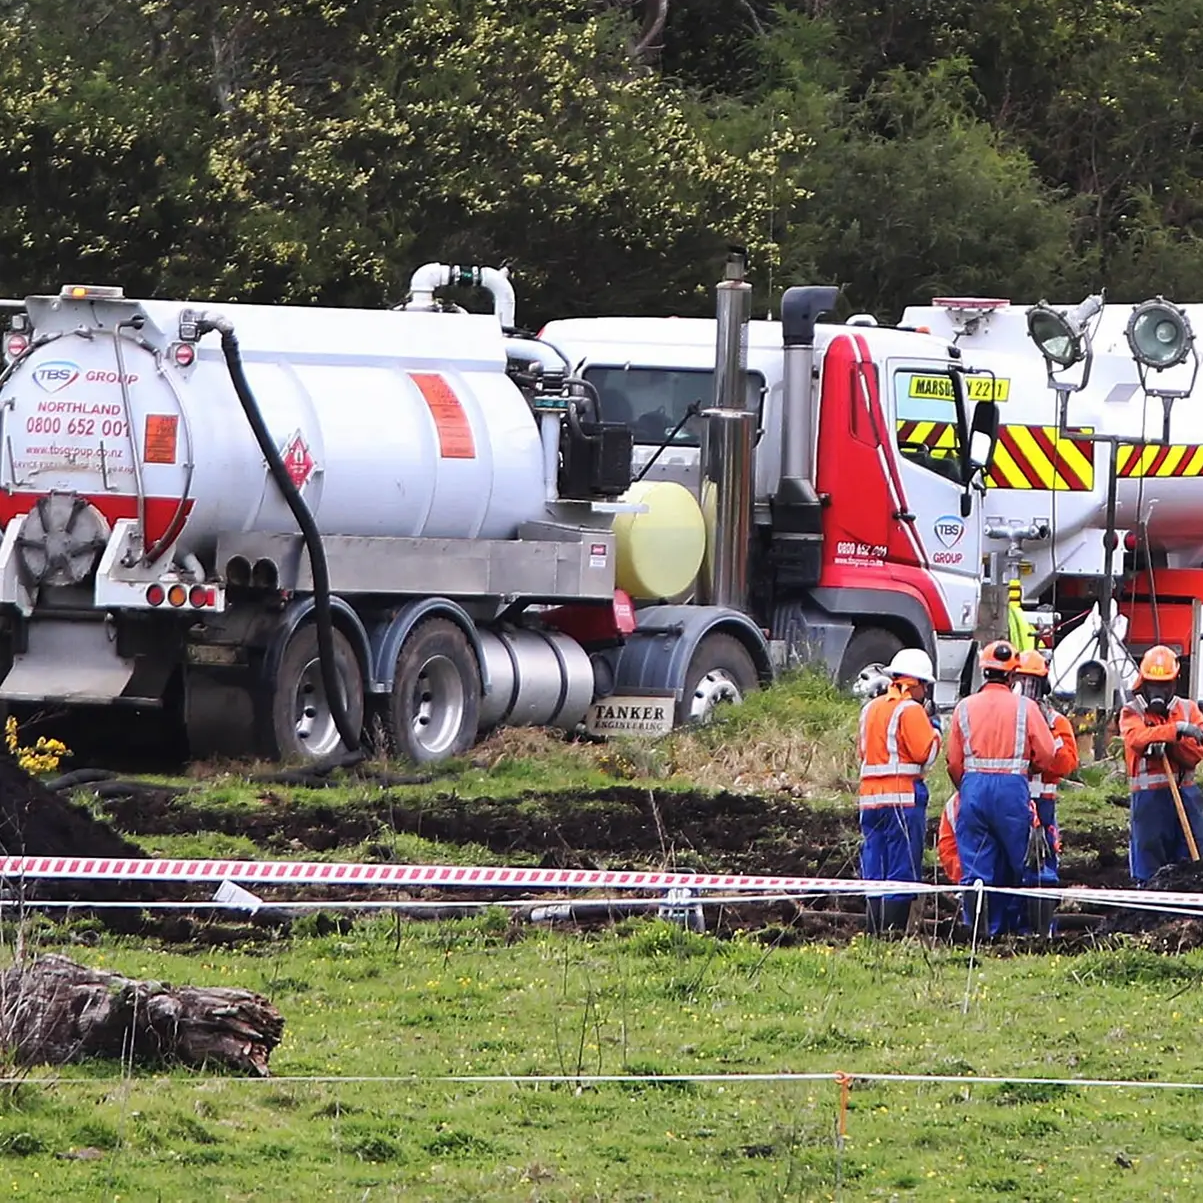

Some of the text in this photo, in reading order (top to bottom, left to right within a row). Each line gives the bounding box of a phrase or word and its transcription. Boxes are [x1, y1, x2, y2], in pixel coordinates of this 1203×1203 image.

[39, 369, 139, 385] TBS GROUP
[975, 380, 1002, 397] 221
[37, 401, 121, 415] NORTHLAND
[26, 416, 130, 438] 0800 652 001
[938, 524, 959, 535] TBS
[837, 542, 855, 555] 0800
[933, 552, 963, 564] GROUP
[594, 705, 665, 720] TANKER
[594, 720, 664, 730] ENGINEERING
